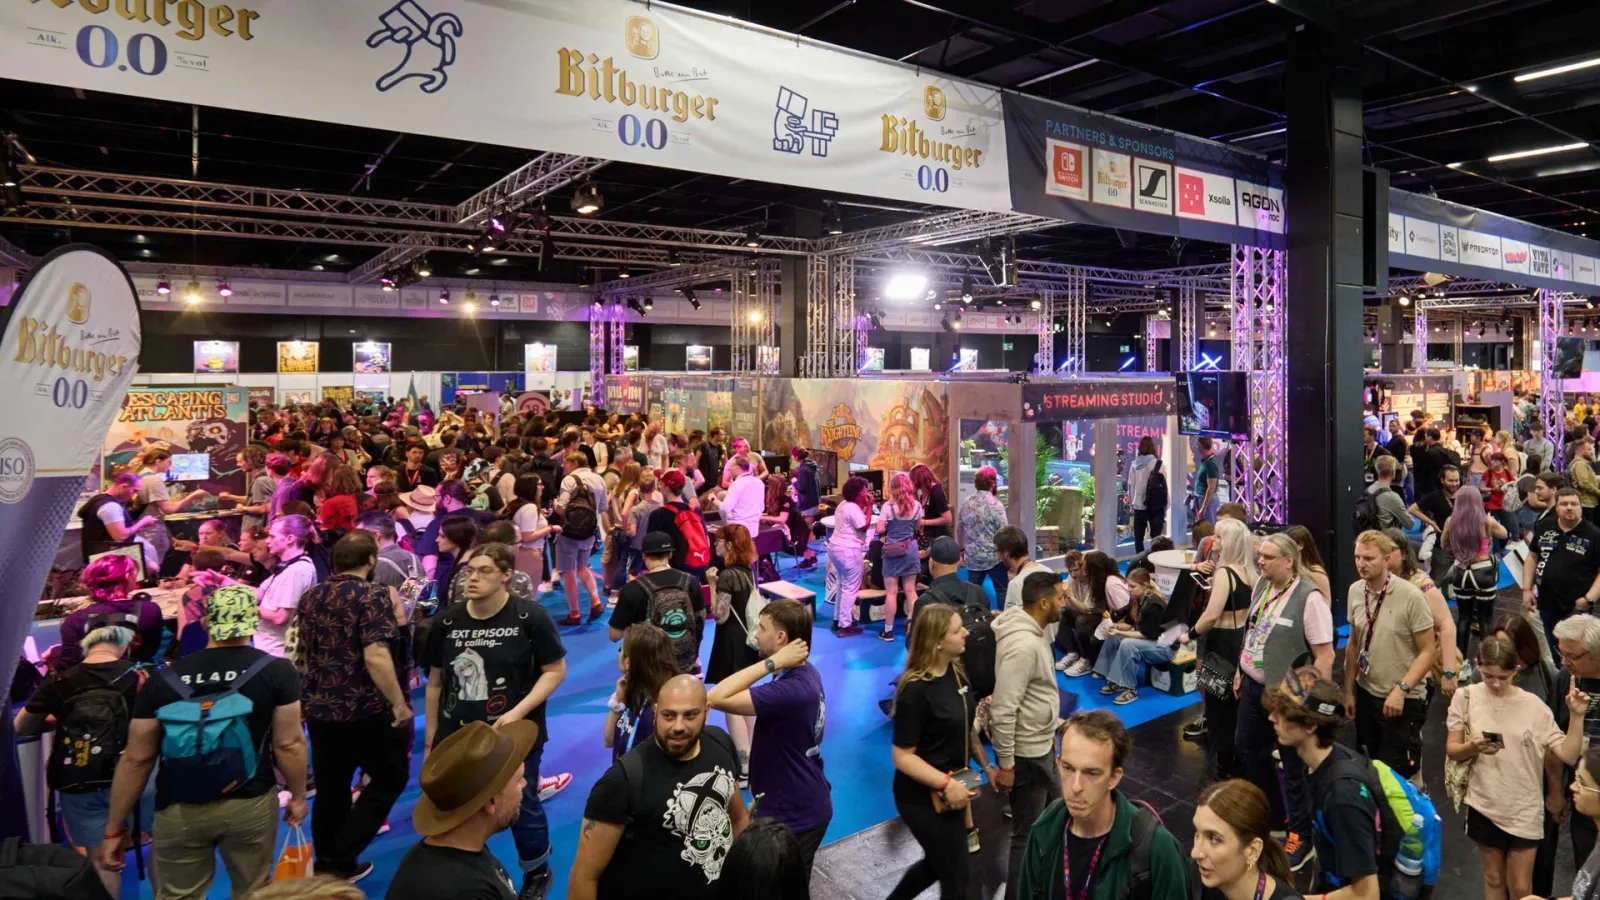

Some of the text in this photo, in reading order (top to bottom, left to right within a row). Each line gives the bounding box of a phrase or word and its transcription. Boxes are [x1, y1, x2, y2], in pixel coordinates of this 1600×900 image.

[37, 33, 61, 44] Alk.
[76, 24, 167, 76] 0.0
[555, 47, 719, 123] Bitburger
[617, 114, 668, 150] 0.0
[1045, 119, 1175, 160] PARTNERS & SPONSORS
[879, 113, 982, 171] Bitburger
[917, 165, 949, 193] 0.0
[1097, 171, 1128, 189] Bitburger
[1139, 198, 1168, 209] SENNHEISER
[1208, 194, 1231, 206] Xsolla
[1241, 191, 1280, 213] AGON
[1469, 243, 1499, 256] PREDATOR
[13, 315, 127, 381] Bitburger
[53, 377, 88, 409] 0.0
[127, 390, 223, 407] ESCAPING
[1045, 391, 1163, 409] STREAMING STUDIO
[118, 404, 226, 422] ATLANTIS
[447, 627, 520, 639] EXT EPISODE
[455, 639, 463, 647] is
[180, 669, 248, 685] BLAD
